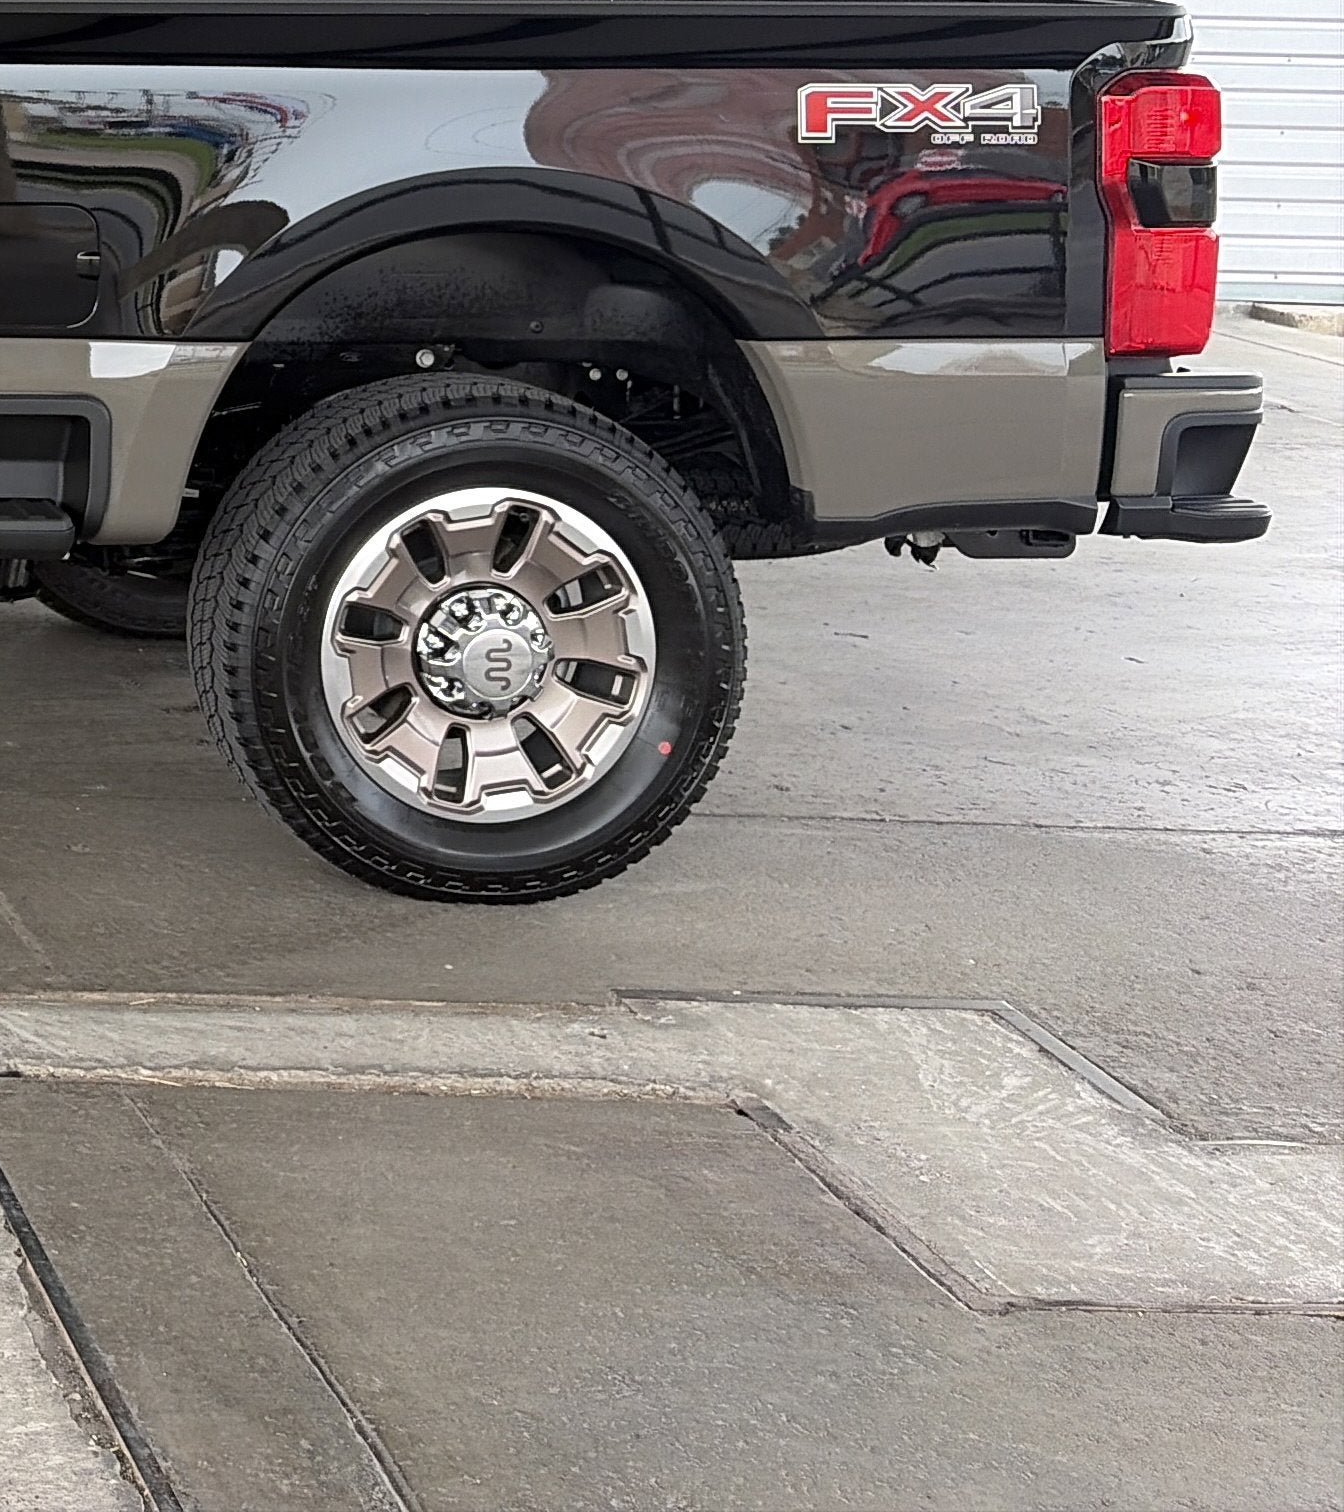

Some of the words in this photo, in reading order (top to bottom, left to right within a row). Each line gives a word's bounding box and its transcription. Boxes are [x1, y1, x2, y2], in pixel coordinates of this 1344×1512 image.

[797, 83, 1042, 144] FX4
[931, 134, 974, 145] OFF
[980, 134, 1038, 145] ROAD
